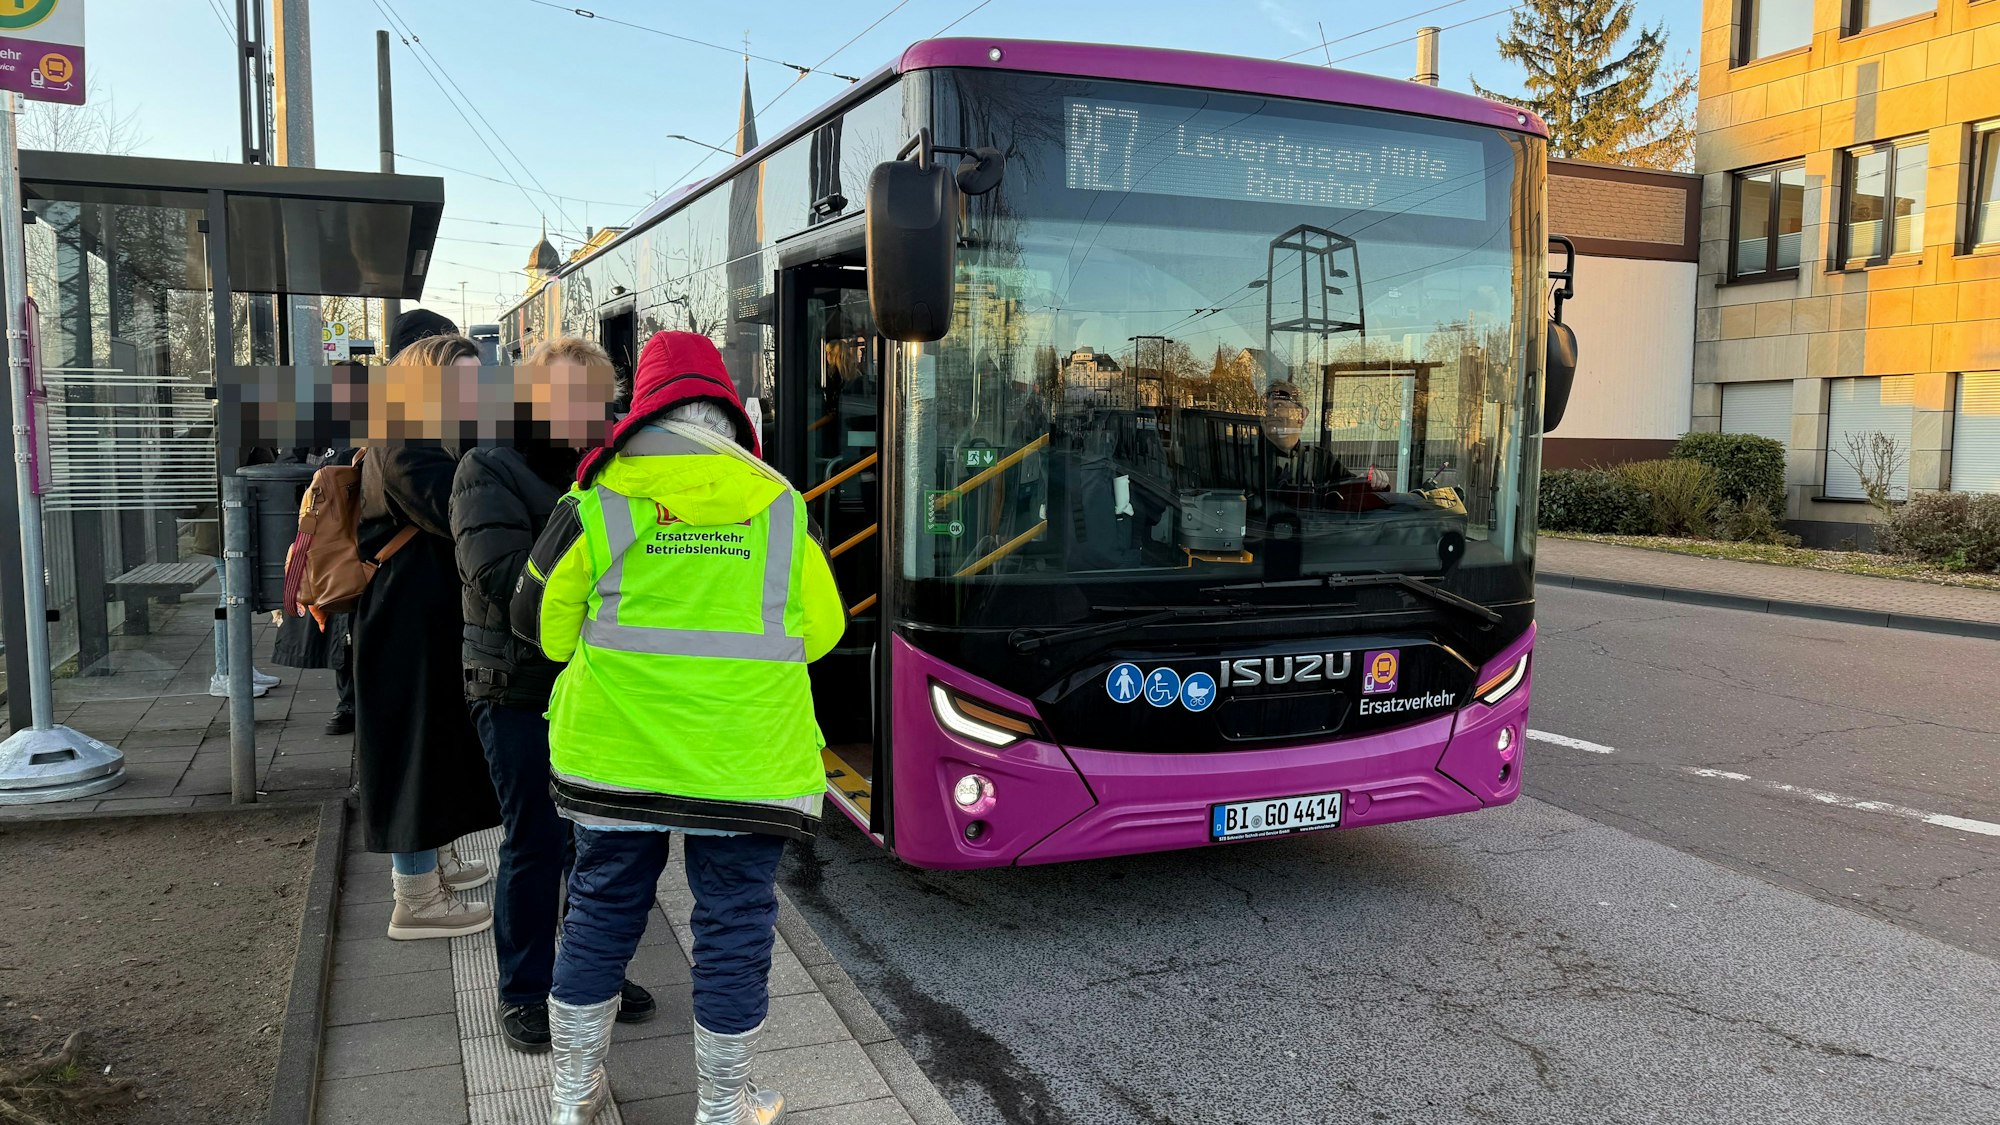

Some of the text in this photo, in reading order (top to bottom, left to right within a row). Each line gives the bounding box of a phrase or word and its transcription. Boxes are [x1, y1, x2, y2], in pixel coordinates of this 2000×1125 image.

[1070, 103, 1139, 191] RE7
[1178, 123, 1372, 173] Leverkusen
[1248, 166, 1380, 205] Bahnhof
[646, 544, 751, 559] Betriebslenkung
[655, 531, 744, 543] Ersatzverkehr
[1219, 652, 1351, 688] ISUZU
[1359, 690, 1455, 716] Ersatzverkehr
[1226, 797, 1337, 830] BI GO 4414
